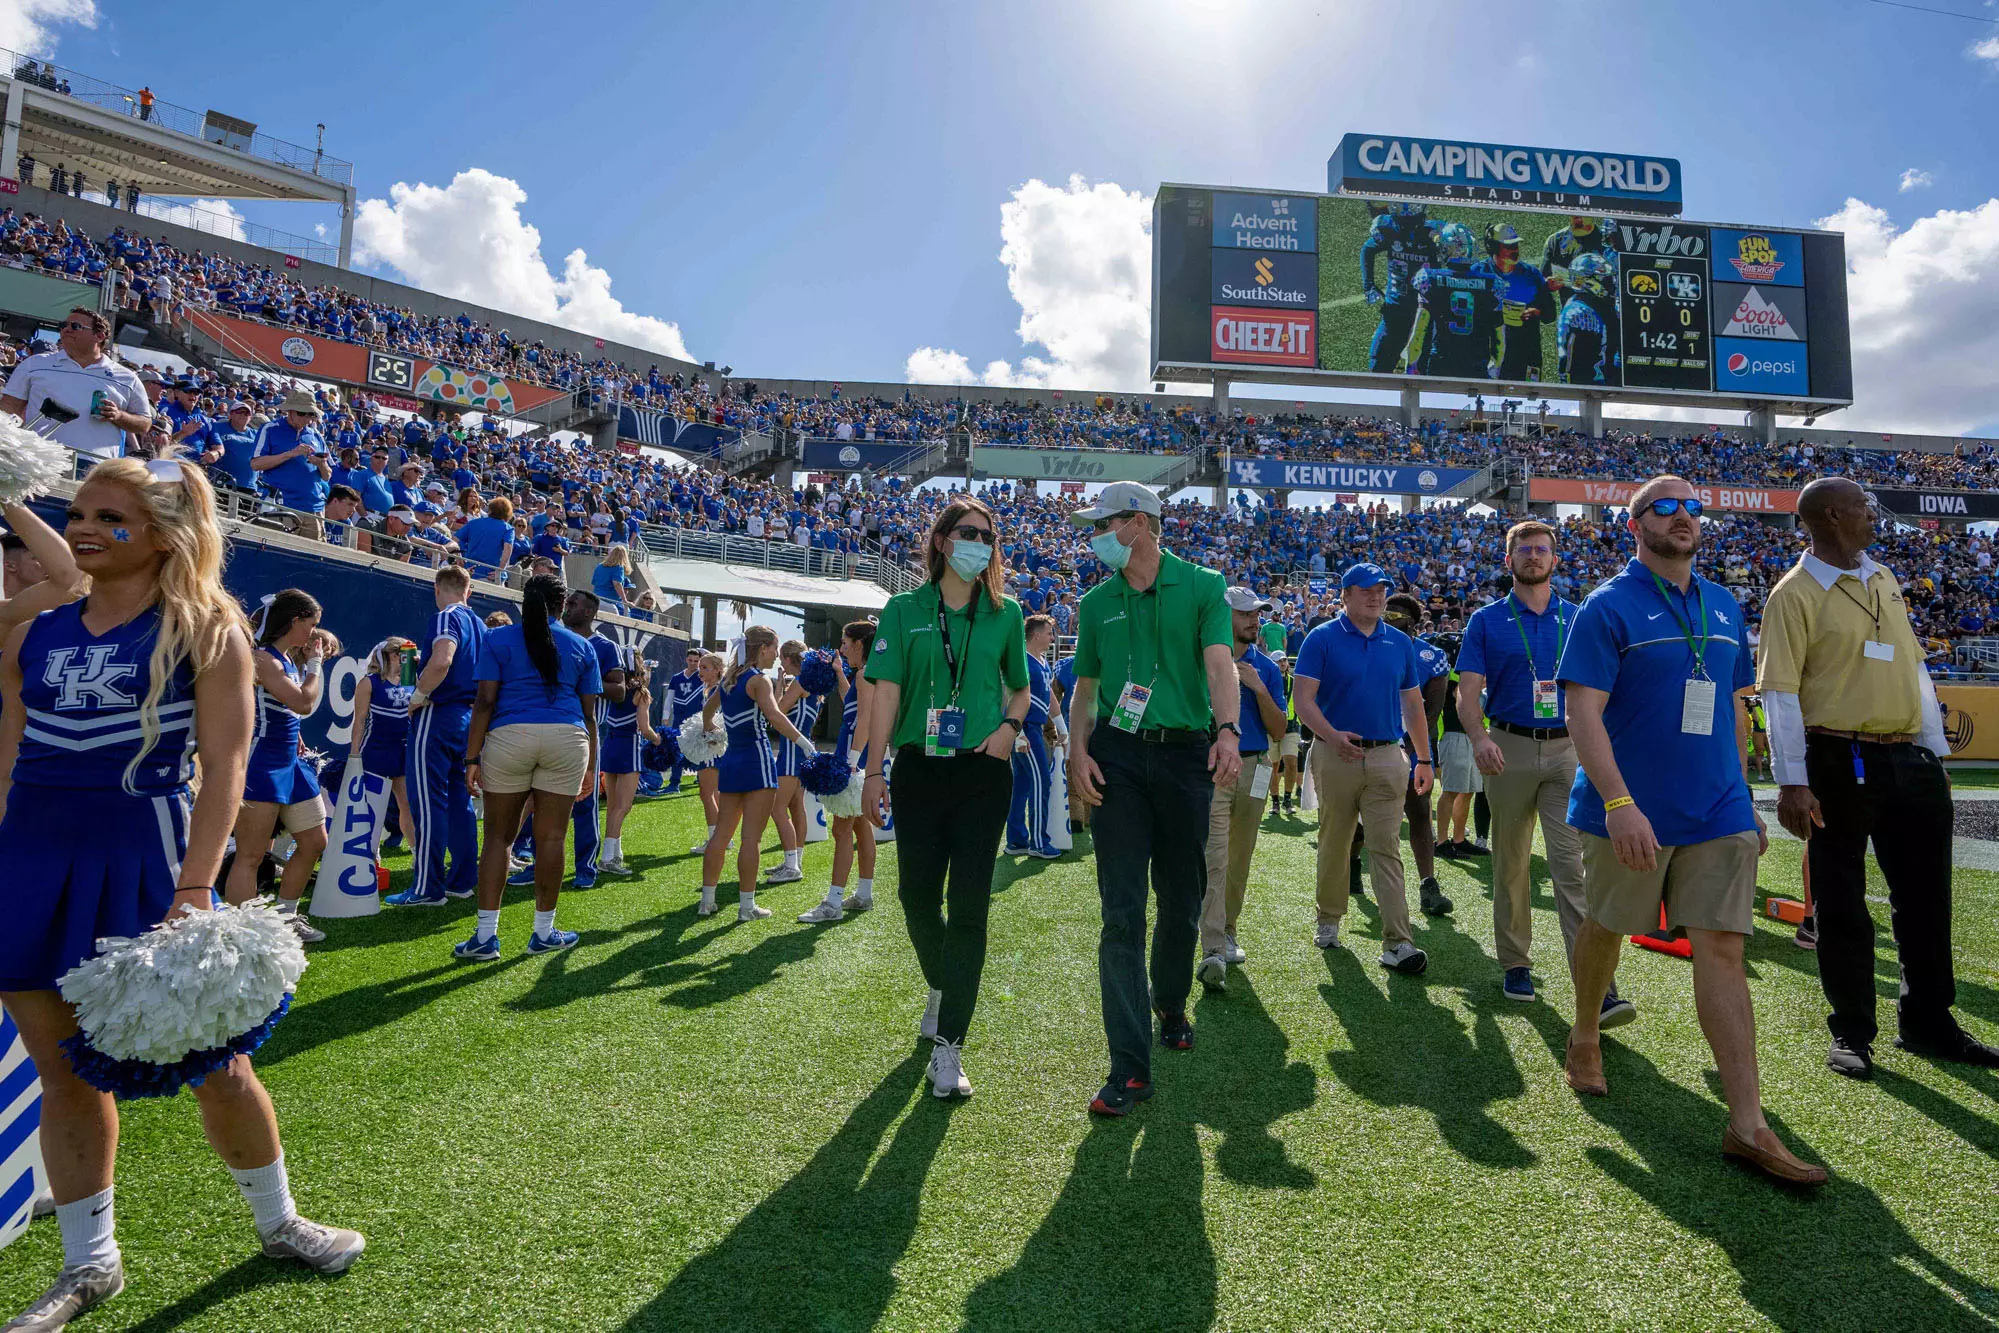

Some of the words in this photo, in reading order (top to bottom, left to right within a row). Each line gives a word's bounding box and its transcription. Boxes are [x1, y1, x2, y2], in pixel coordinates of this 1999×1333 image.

[1358, 138, 1531, 183] CAMPING
[1535, 152, 1671, 193] WORLD
[0, 181, 18, 193] P15
[1444, 184, 1591, 207] STADIUM
[1230, 212, 1298, 232] Advent
[1236, 231, 1299, 251] Health
[1619, 224, 1705, 257] Vrbo
[1738, 236, 1770, 253] FUN
[285, 256, 300, 268] P16
[1741, 249, 1778, 264] SPOT
[1221, 284, 1307, 303] SouthState
[1448, 290, 1475, 336] 9
[1640, 305, 1651, 324] 0
[1680, 308, 1691, 327] 0
[1732, 301, 1787, 326] Coors
[1742, 323, 1778, 336] LIGHT
[1639, 331, 1678, 350] 1:42
[1688, 342, 1695, 355] 1
[374, 356, 408, 386] 25
[1752, 360, 1796, 376] pepsi
[1040, 455, 1105, 477] Vrbo
[1284, 465, 1398, 489] KENTUCKY
[1719, 491, 1775, 509] BOWL
[1919, 495, 1969, 514] IOWA
[42, 643, 139, 711] UK
[337, 774, 378, 897] CATS
